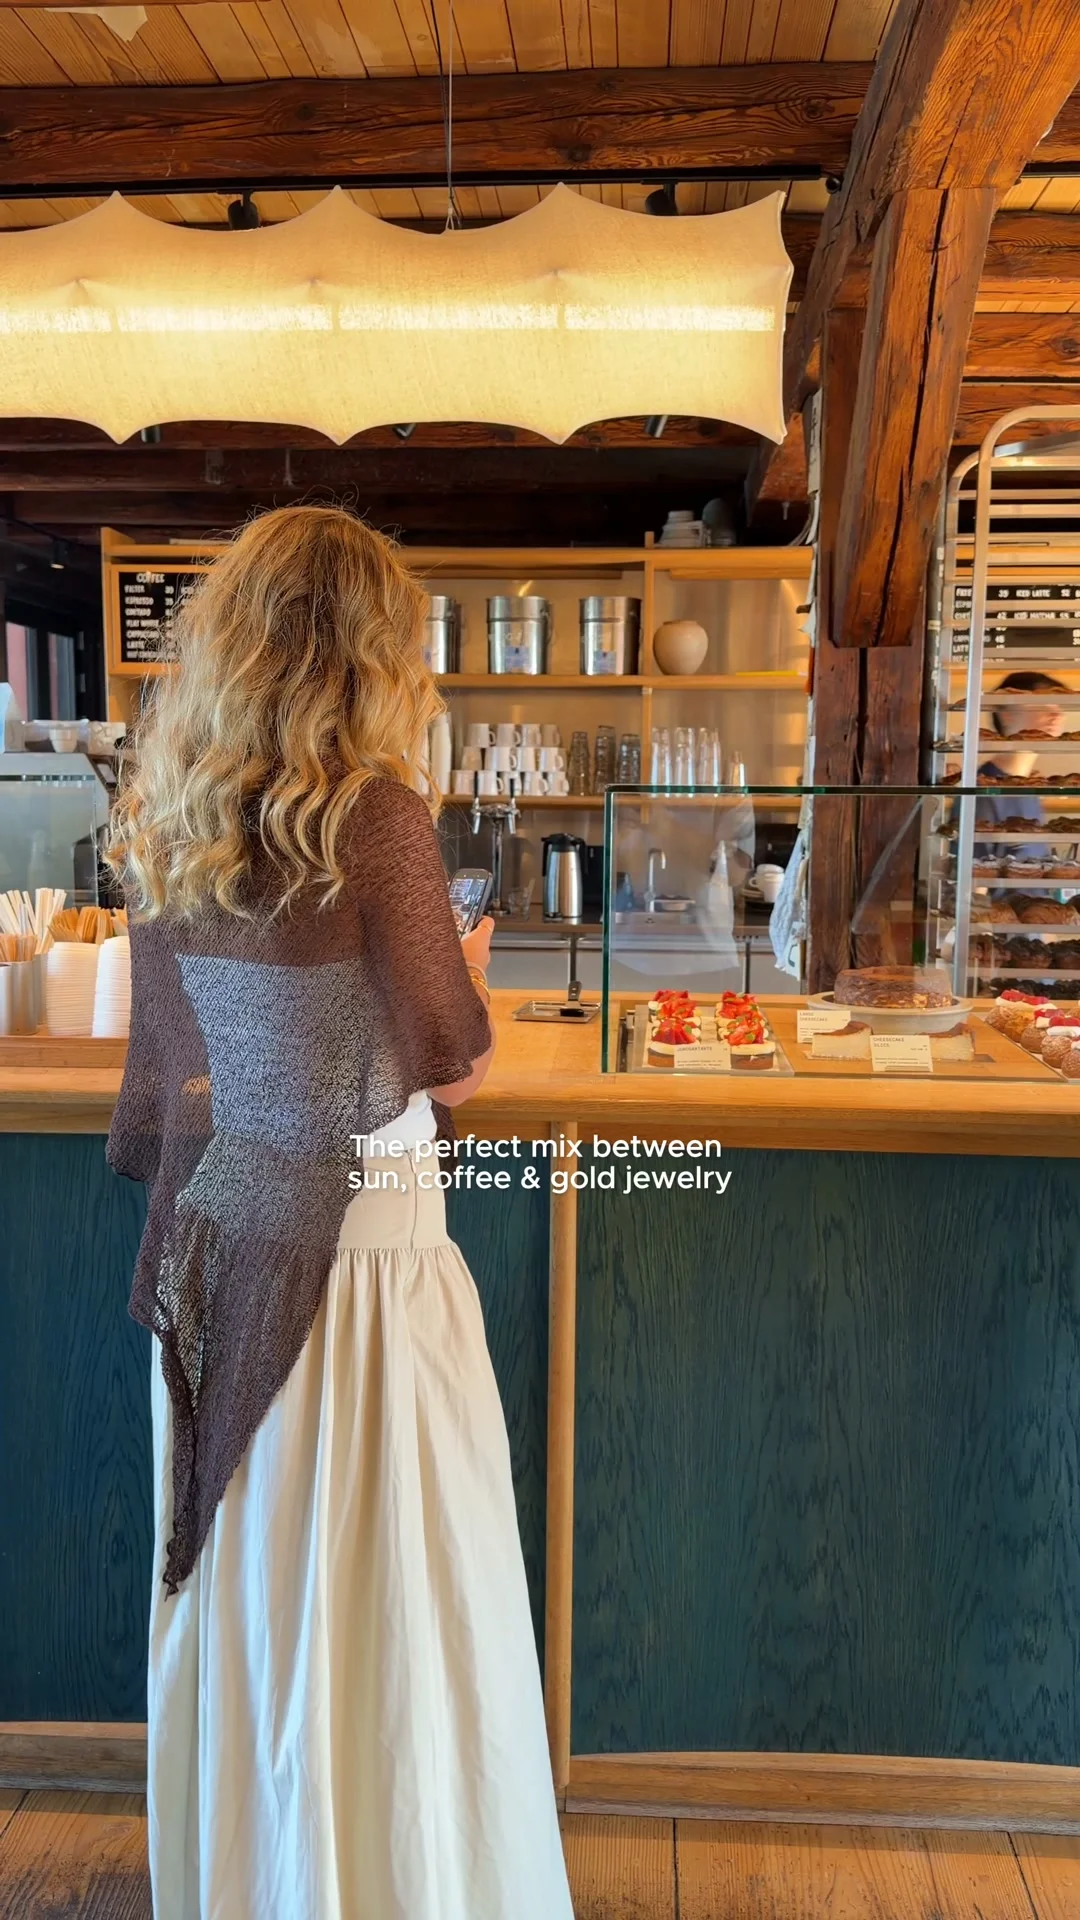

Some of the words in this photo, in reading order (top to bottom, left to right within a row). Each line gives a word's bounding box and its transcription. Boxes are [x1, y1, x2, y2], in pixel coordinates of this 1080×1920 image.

[136, 573, 165, 583] COFFEE
[1016, 589, 1030, 597] ICED
[1031, 589, 1051, 597] LATTE
[125, 597, 154, 605] ESPRESSO
[125, 608, 151, 616] CORTADO
